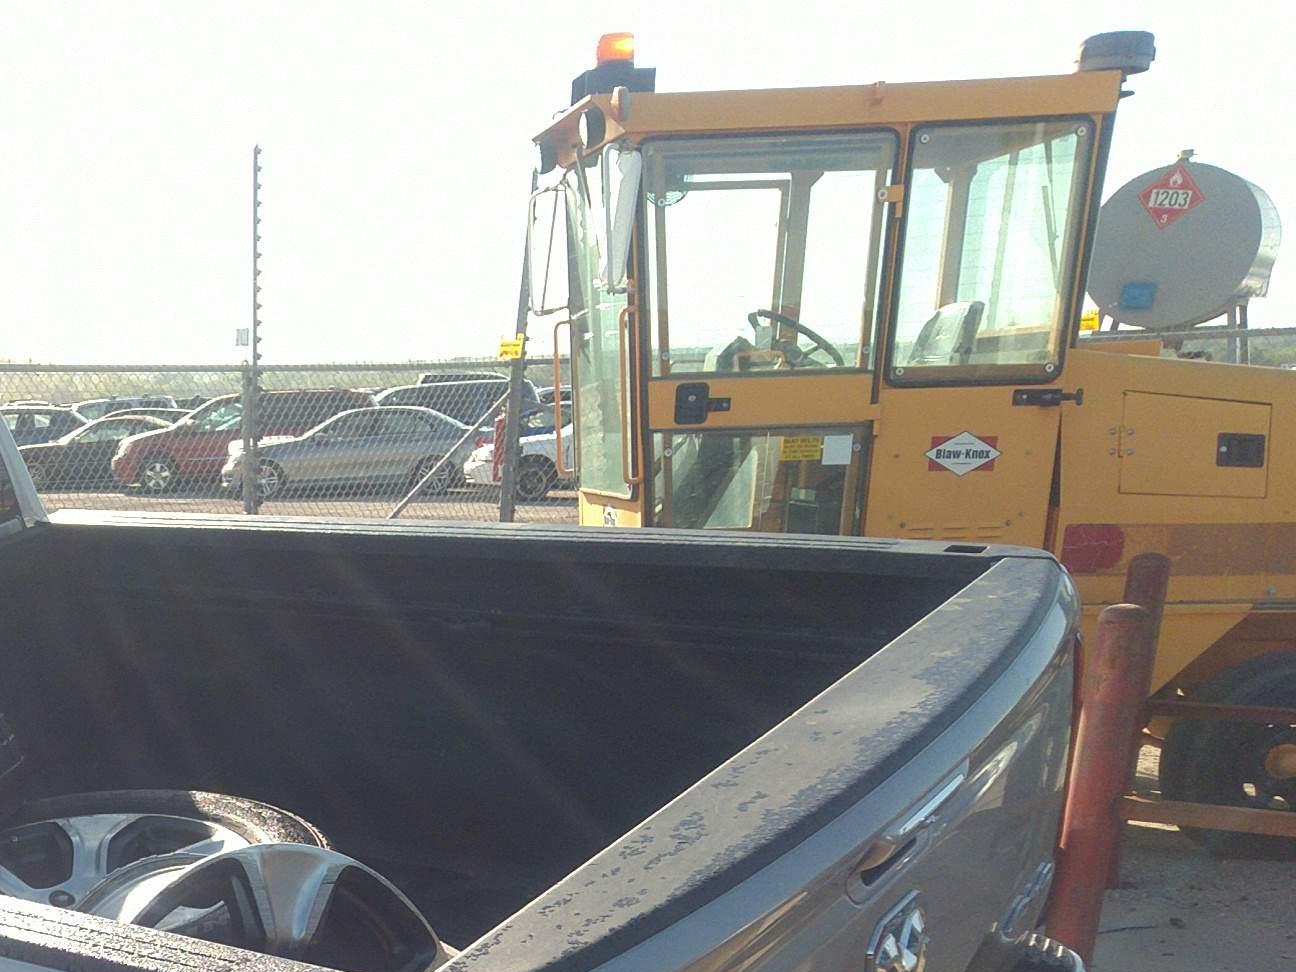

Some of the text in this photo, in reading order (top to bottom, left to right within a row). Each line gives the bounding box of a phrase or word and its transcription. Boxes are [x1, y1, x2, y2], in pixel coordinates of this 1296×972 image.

[1153, 190, 1191, 208] 1203
[1160, 213, 1169, 224] 3
[935, 448, 992, 460] Blaw-Knox
